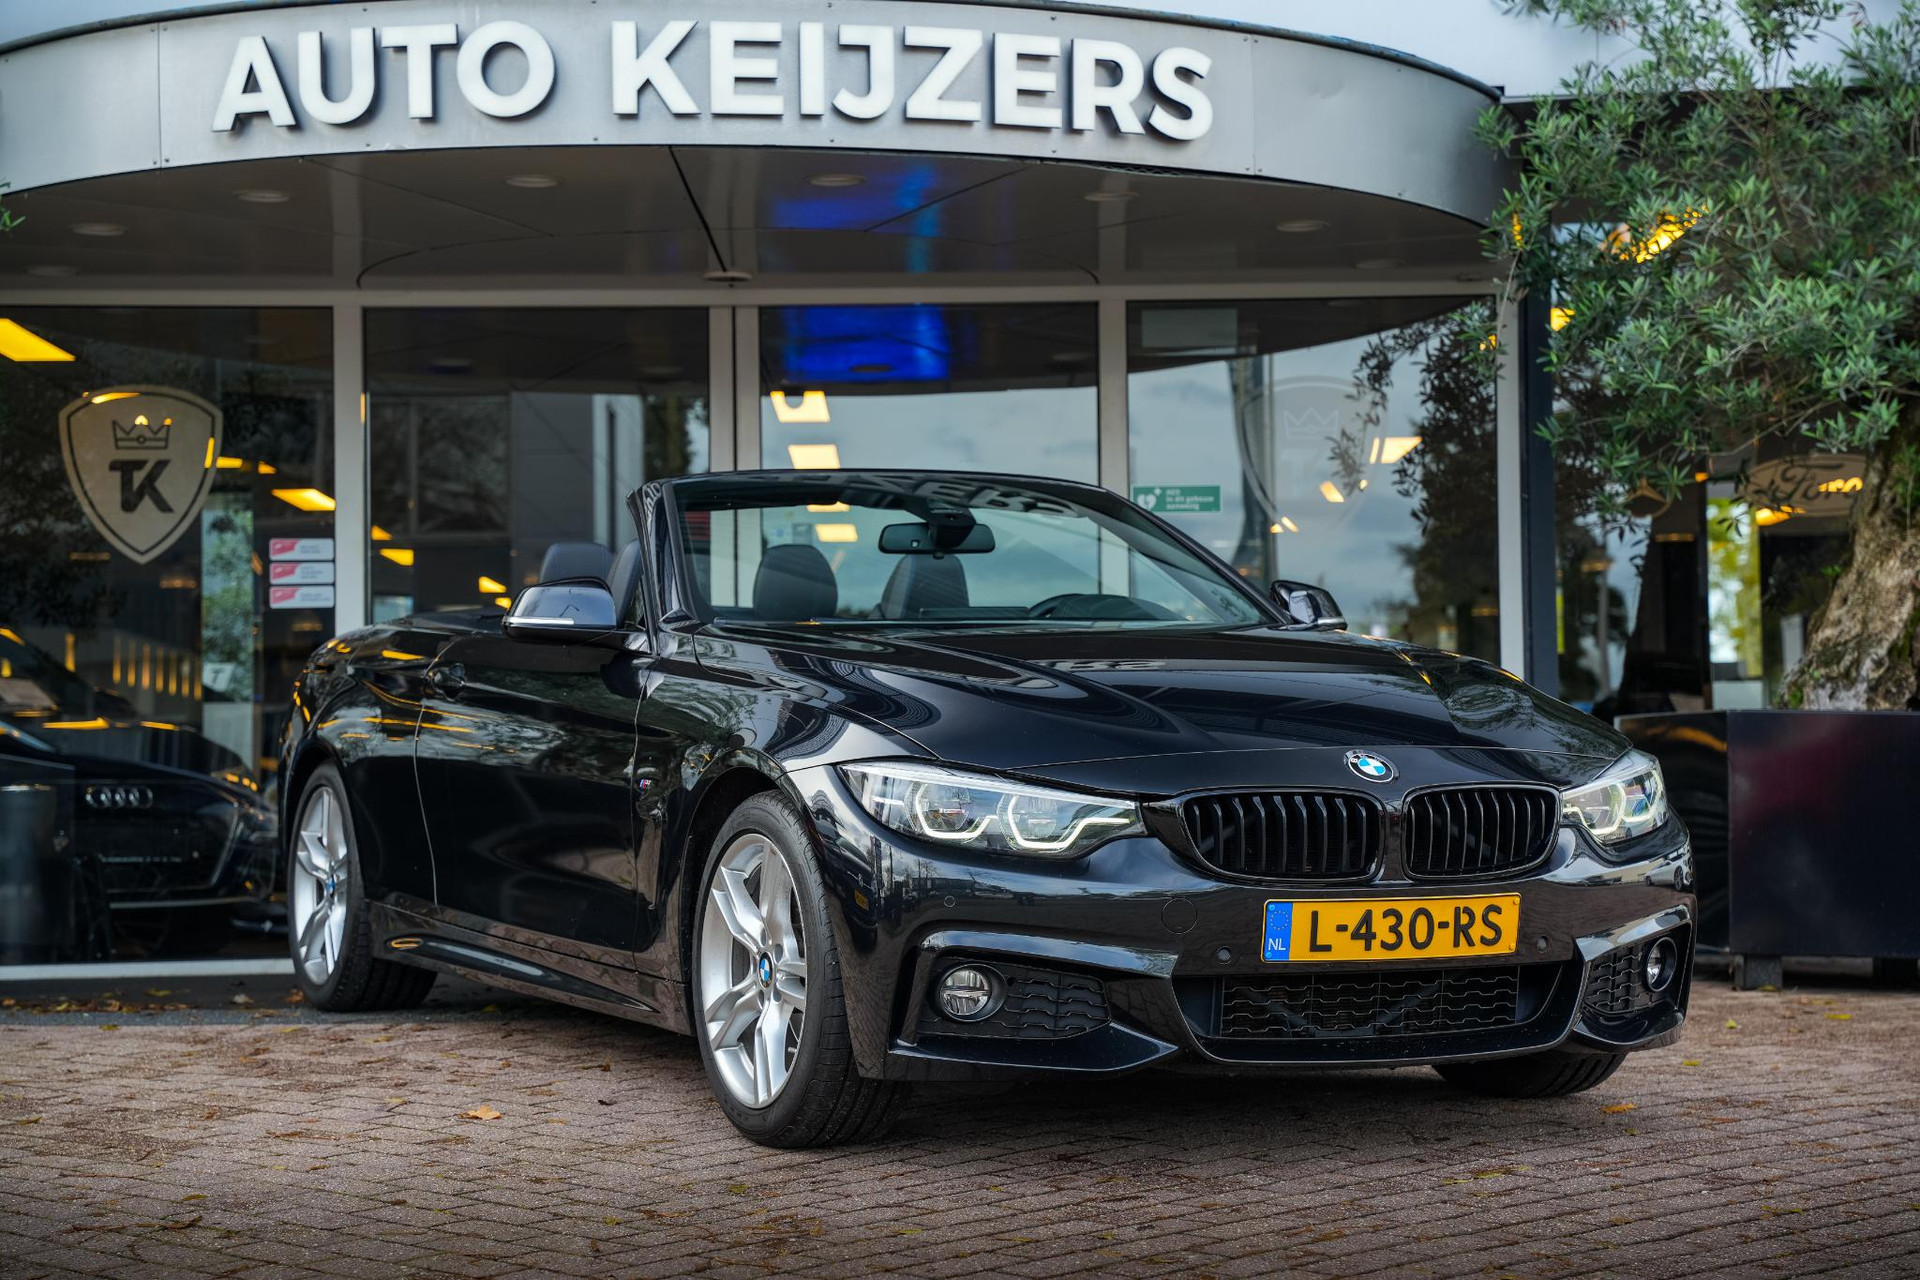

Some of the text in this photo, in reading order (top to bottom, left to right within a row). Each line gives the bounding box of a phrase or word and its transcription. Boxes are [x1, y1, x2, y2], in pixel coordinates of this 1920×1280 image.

[211, 20, 1214, 141] AUTO KEIJZERS
[109, 459, 174, 513] TK
[1268, 938, 1286, 950] NL
[1310, 904, 1502, 951] L-430-RS
